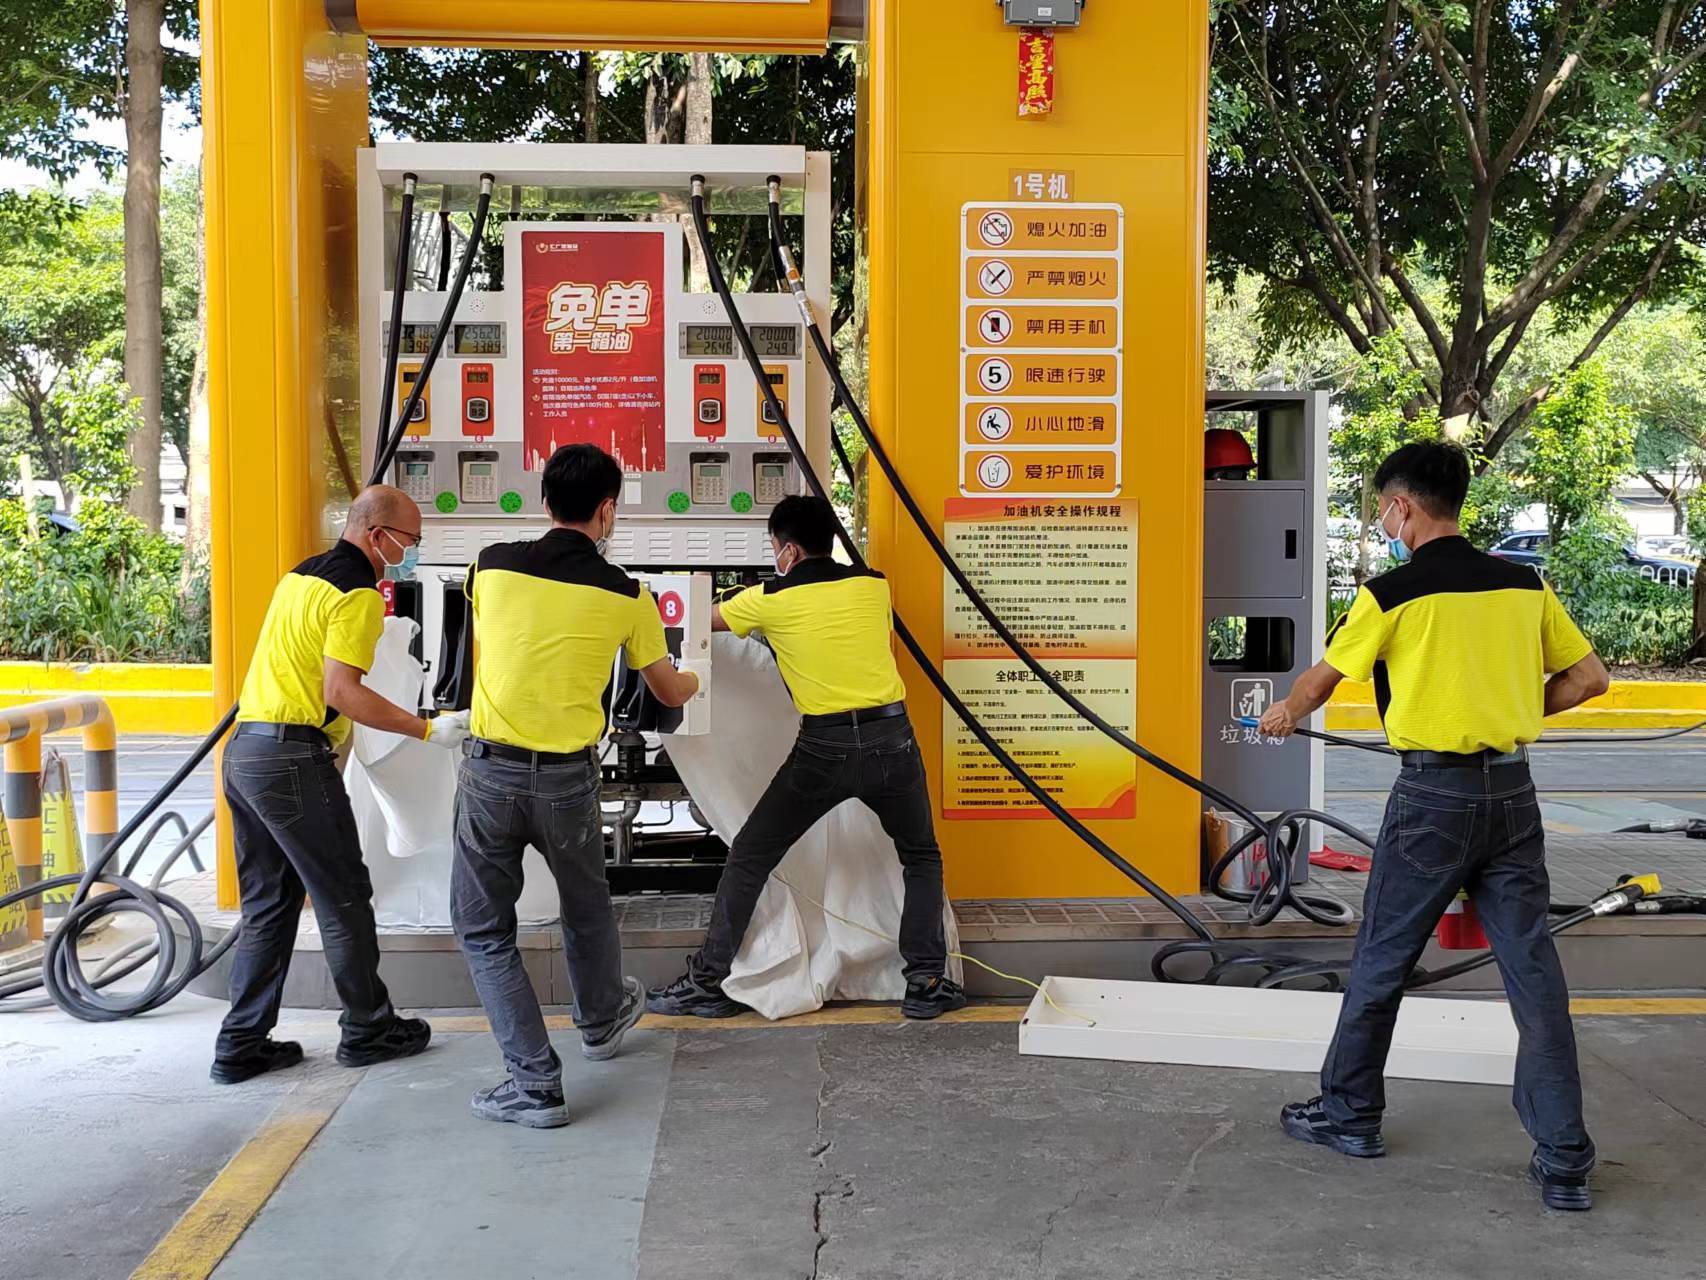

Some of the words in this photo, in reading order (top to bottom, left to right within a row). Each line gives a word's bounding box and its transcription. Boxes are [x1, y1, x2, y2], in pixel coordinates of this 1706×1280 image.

[1025, 37, 1049, 100] 吉星高照
[1013, 172, 1069, 199] 1号机
[1027, 221, 1107, 238] 熄火加油
[1026, 270, 1107, 287] 严禁烟火
[545, 282, 651, 331] 免单
[1026, 319, 1107, 335] 禁用手机
[552, 330, 631, 352] 第一箱油
[988, 366, 1003, 385] 5
[1025, 367, 1107, 385] 限速行驶
[702, 408, 717, 419] 92
[1025, 415, 1106, 432] 小心地滑
[1024, 463, 1106, 480] 爱护环境
[1003, 504, 1122, 518] 加油机安全操作规程
[383, 587, 392, 602] 5
[665, 599, 677, 618] 8
[995, 670, 1085, 683] 全体职工全职责
